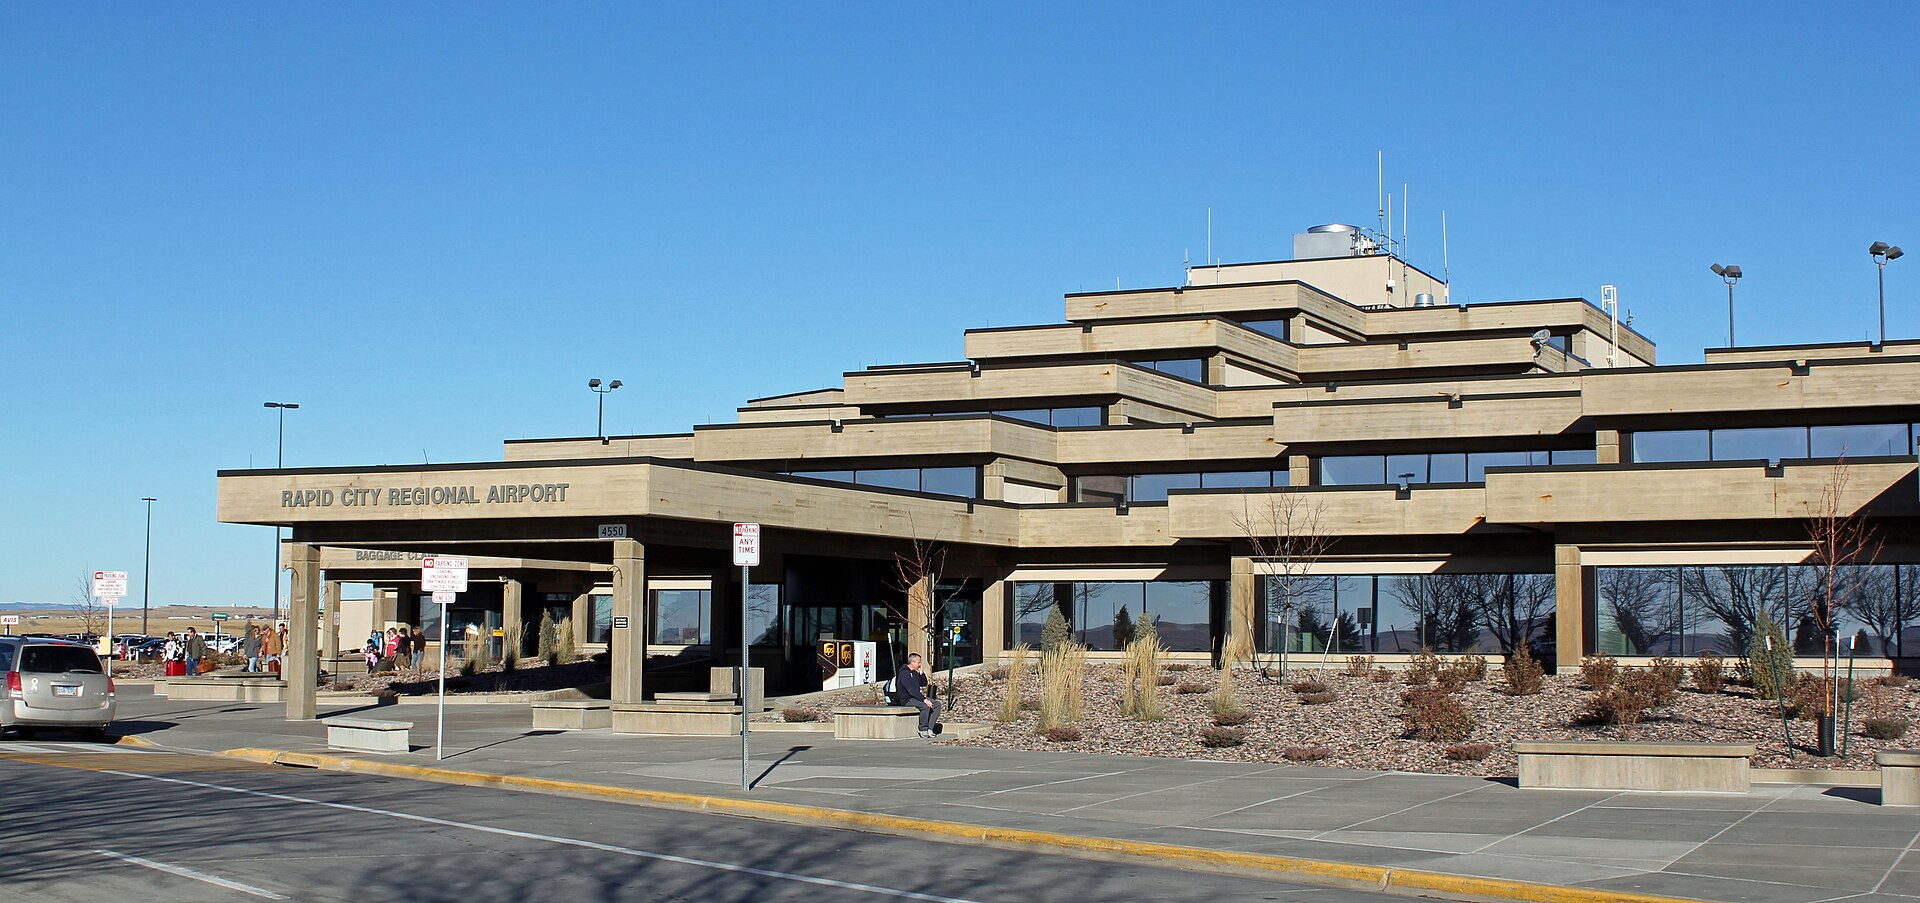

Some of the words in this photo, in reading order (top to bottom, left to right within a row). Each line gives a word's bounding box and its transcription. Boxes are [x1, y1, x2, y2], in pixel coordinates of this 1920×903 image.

[281, 489, 334, 507] RAPID
[340, 488, 382, 506] CITY
[388, 486, 480, 506] REGIONAL
[487, 483, 570, 504] AIRPORT
[601, 526, 624, 537] 4550
[356, 550, 403, 561] BAGGAGE
[738, 546, 755, 554] TIME
[424, 560, 434, 568] NO
[435, 560, 453, 568] PARKING
